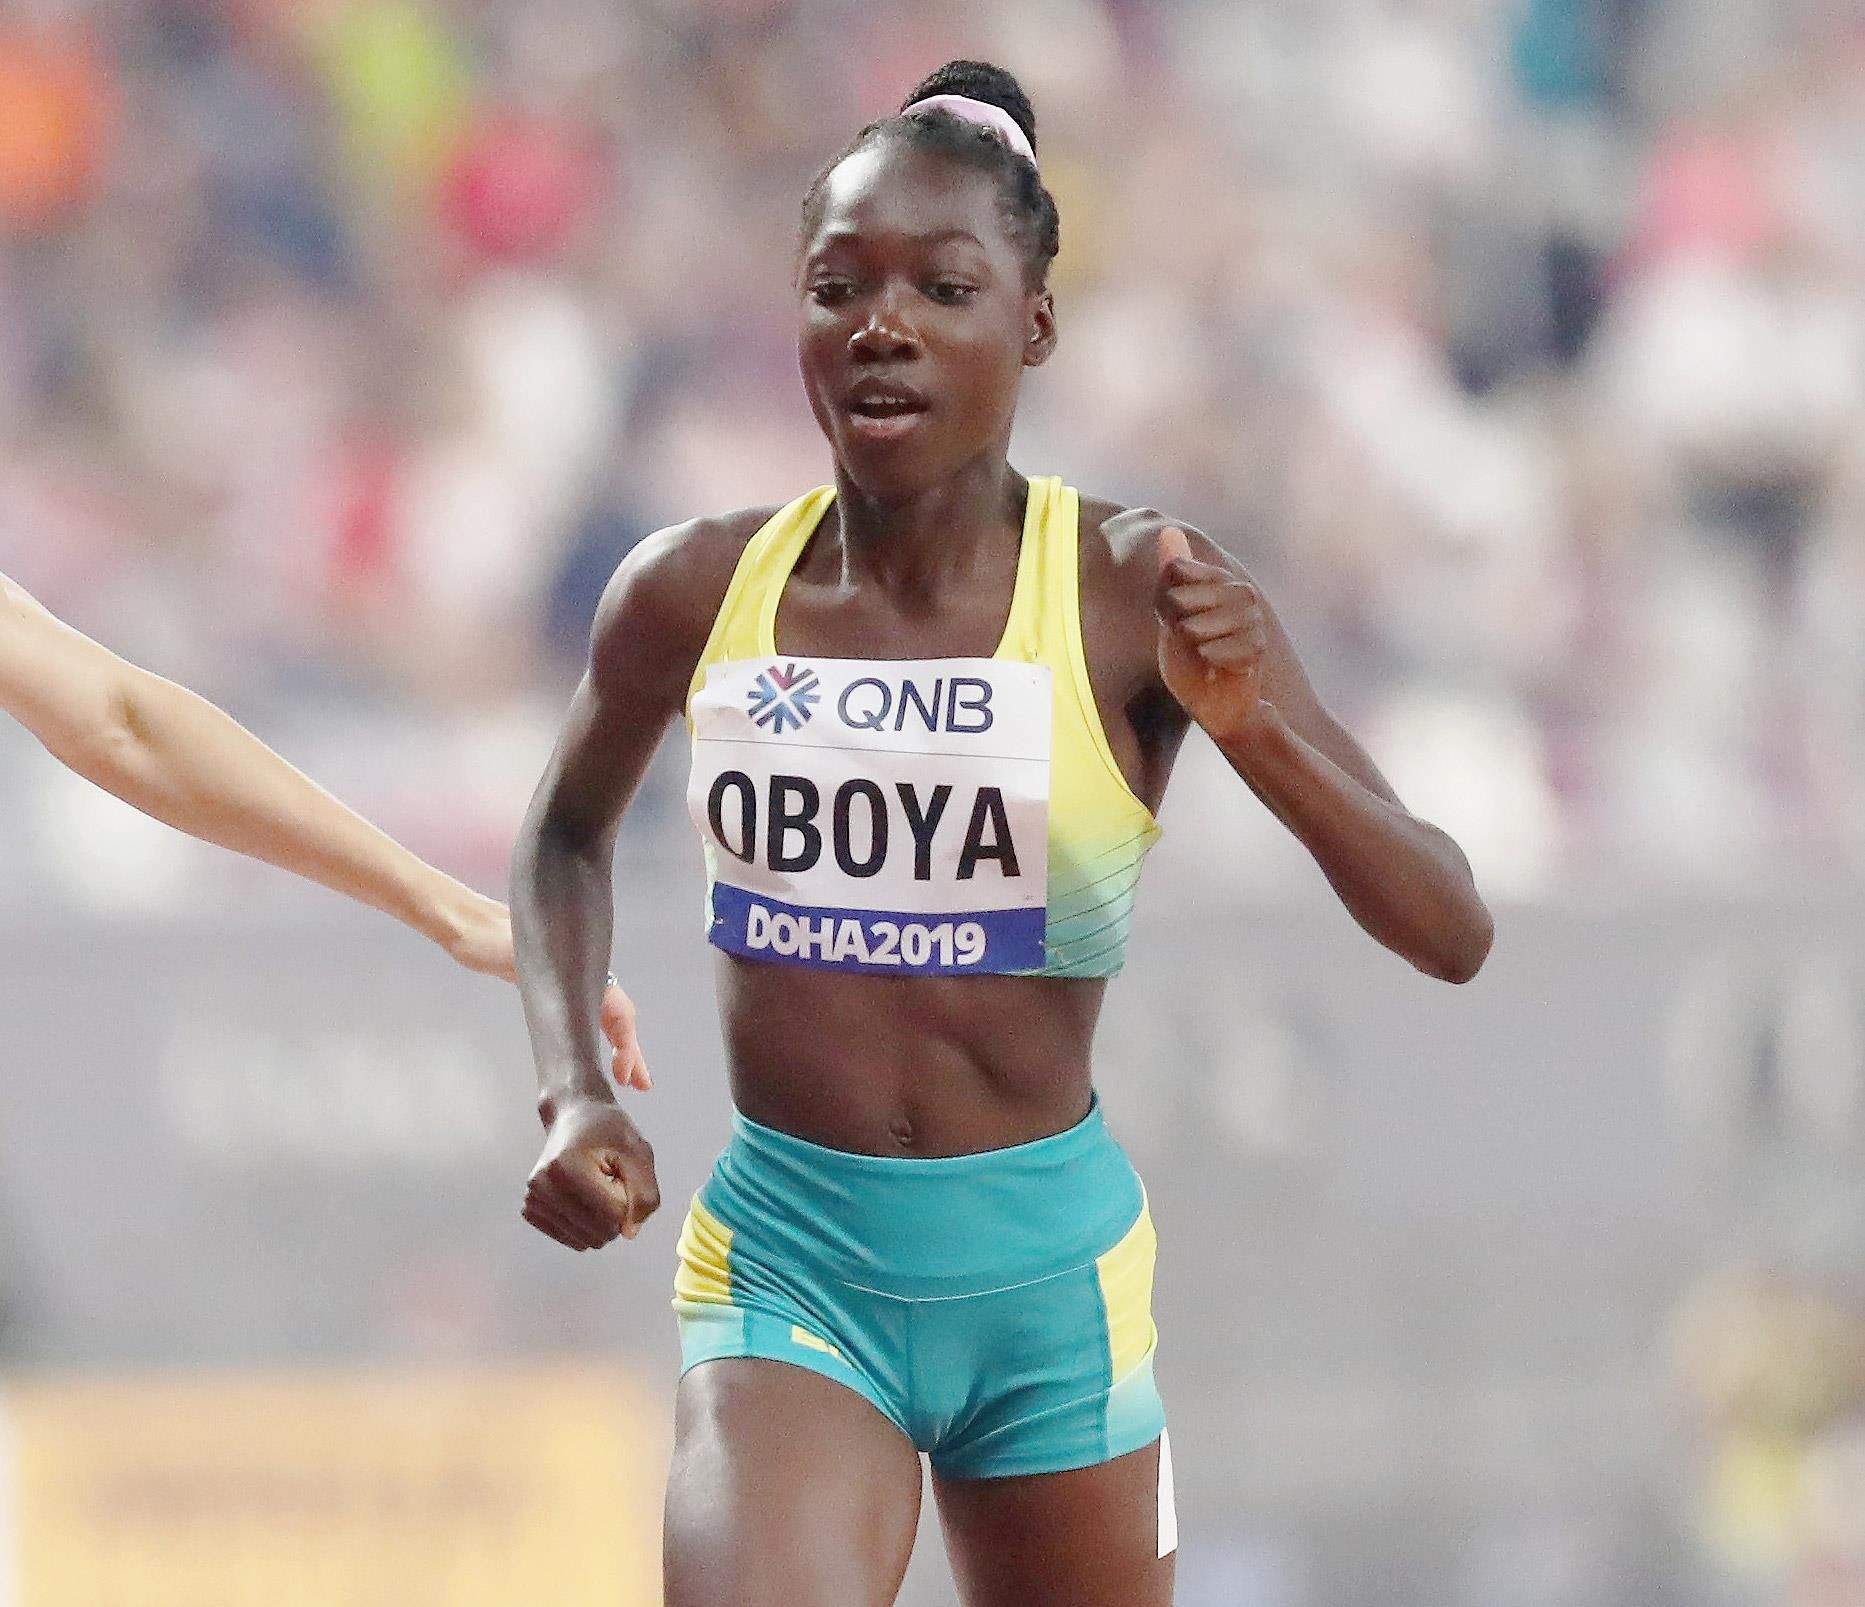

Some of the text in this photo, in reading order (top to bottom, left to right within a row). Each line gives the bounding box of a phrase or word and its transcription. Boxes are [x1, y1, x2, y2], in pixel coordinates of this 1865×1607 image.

[838, 677, 994, 733] QNB
[708, 770, 1021, 880] OBOYA
[746, 903, 986, 966] DOHA2019
